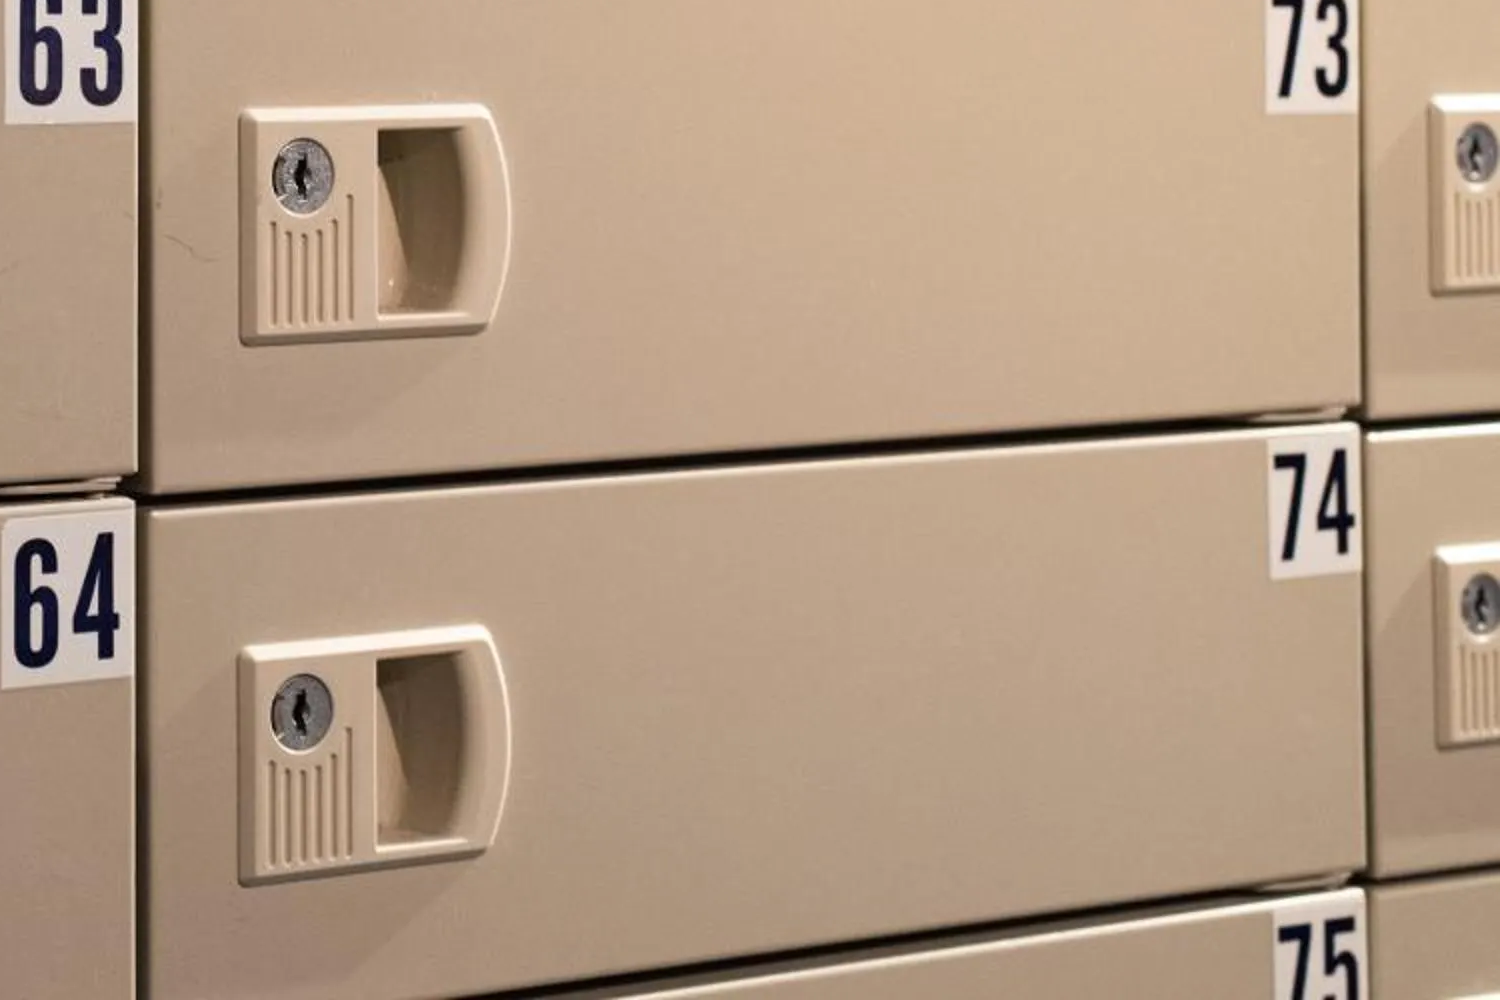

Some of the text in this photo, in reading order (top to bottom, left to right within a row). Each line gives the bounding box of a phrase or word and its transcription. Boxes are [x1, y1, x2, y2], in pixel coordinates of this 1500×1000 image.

[1273, 448, 1355, 561] 74
[13, 531, 120, 669] 64
[1277, 915, 1359, 1000] 75
